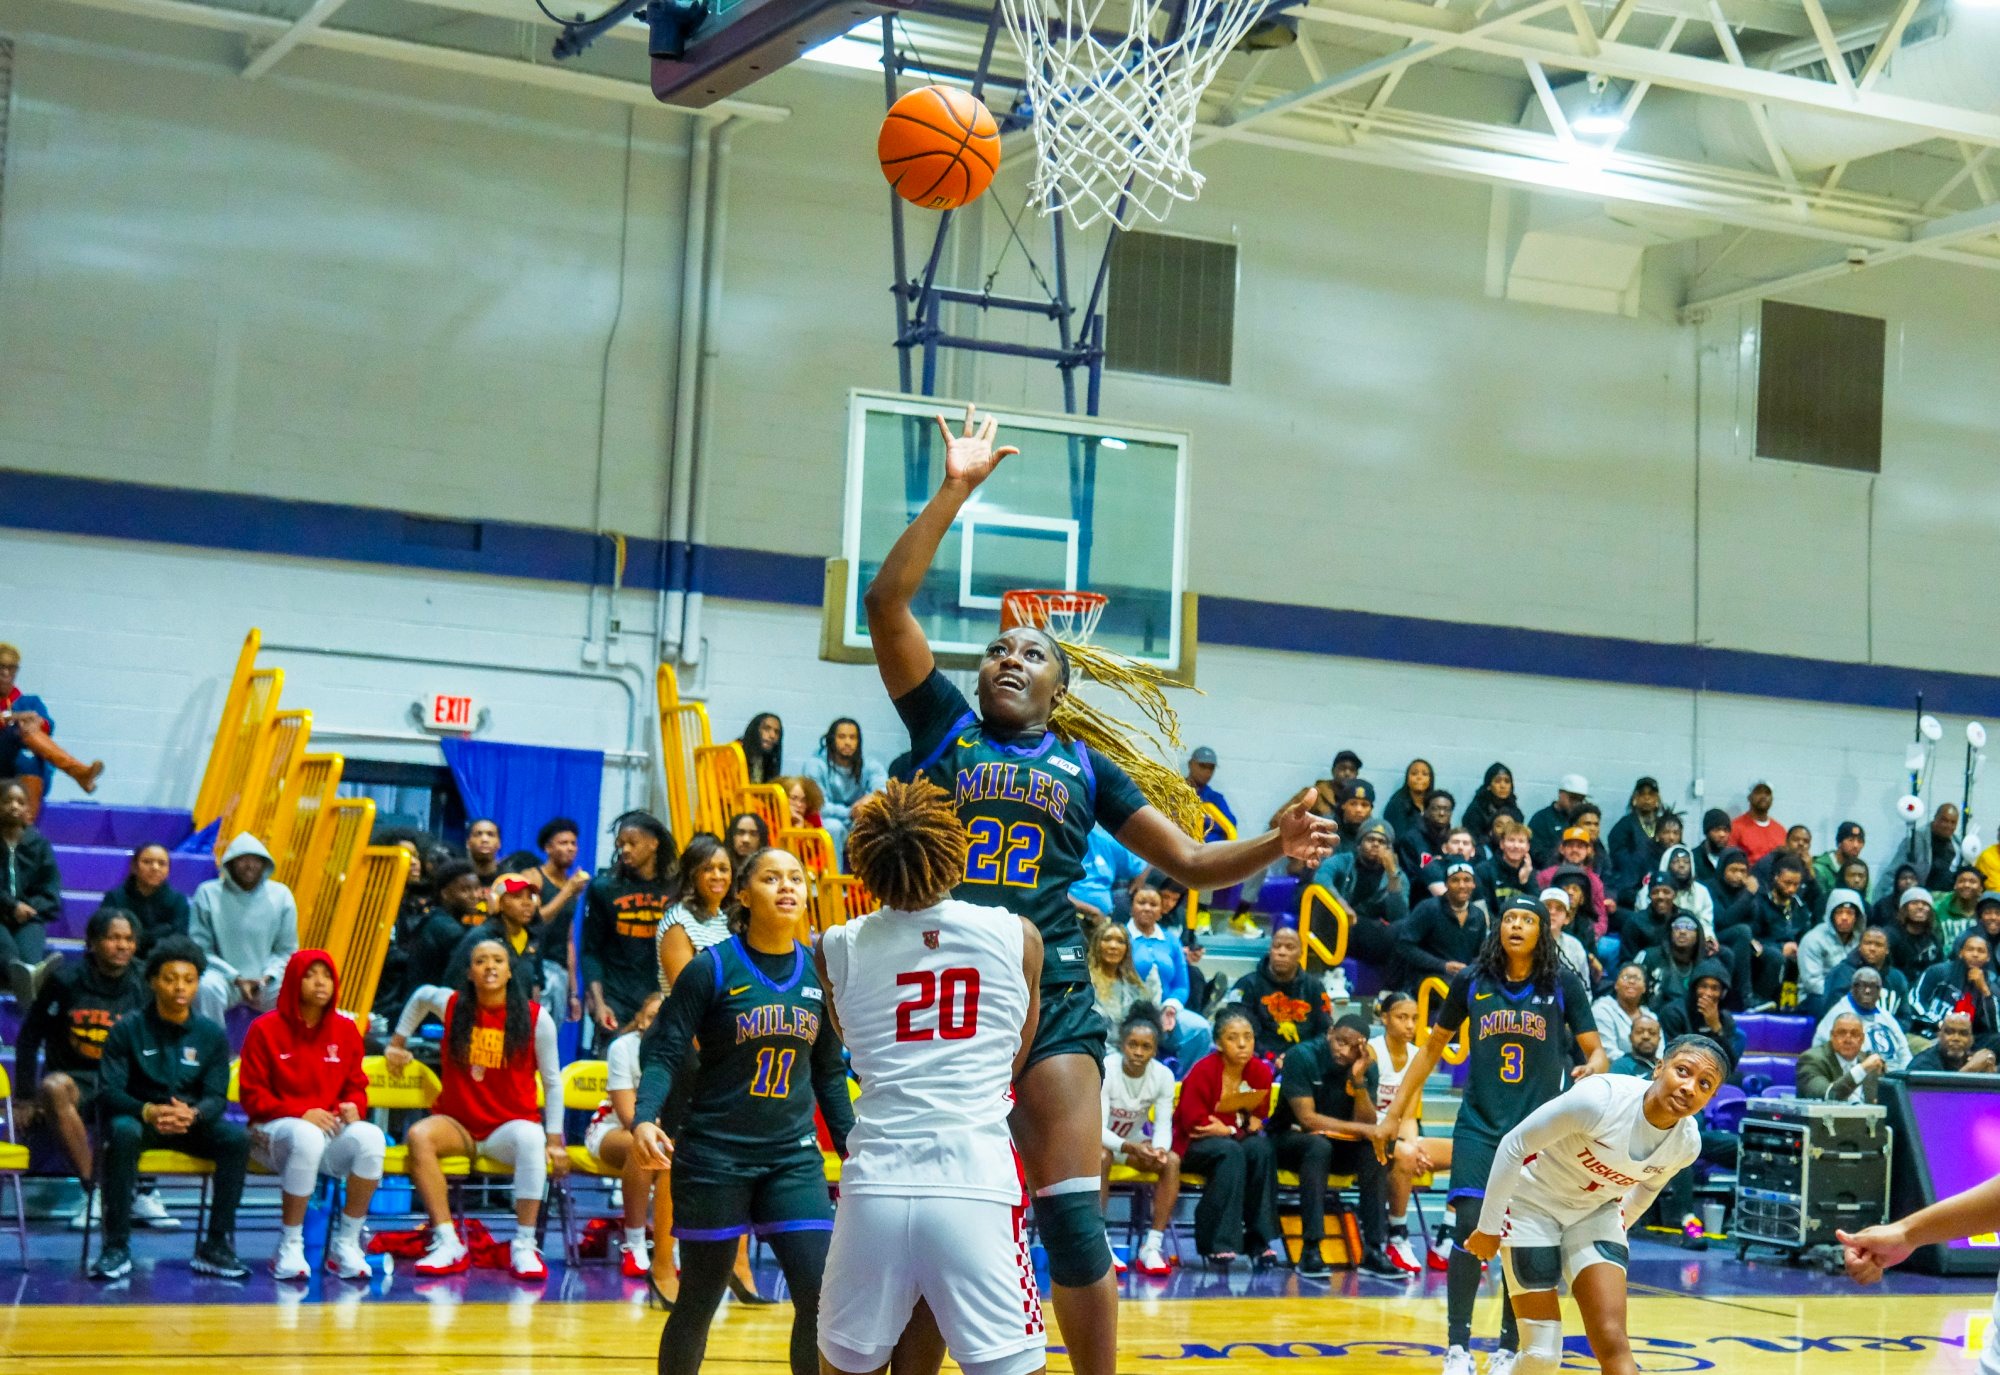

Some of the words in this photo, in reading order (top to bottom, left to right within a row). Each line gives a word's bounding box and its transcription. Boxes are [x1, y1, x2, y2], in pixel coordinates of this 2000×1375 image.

[435, 694, 472, 724] EXIT
[954, 761, 1069, 824] MILES
[962, 815, 1045, 888] 22
[736, 1004, 819, 1046] MILES
[895, 967, 980, 1042] 20
[1478, 1009, 1547, 1041] MILES
[749, 1047, 796, 1099] 11
[1500, 1042, 1524, 1084] 3
